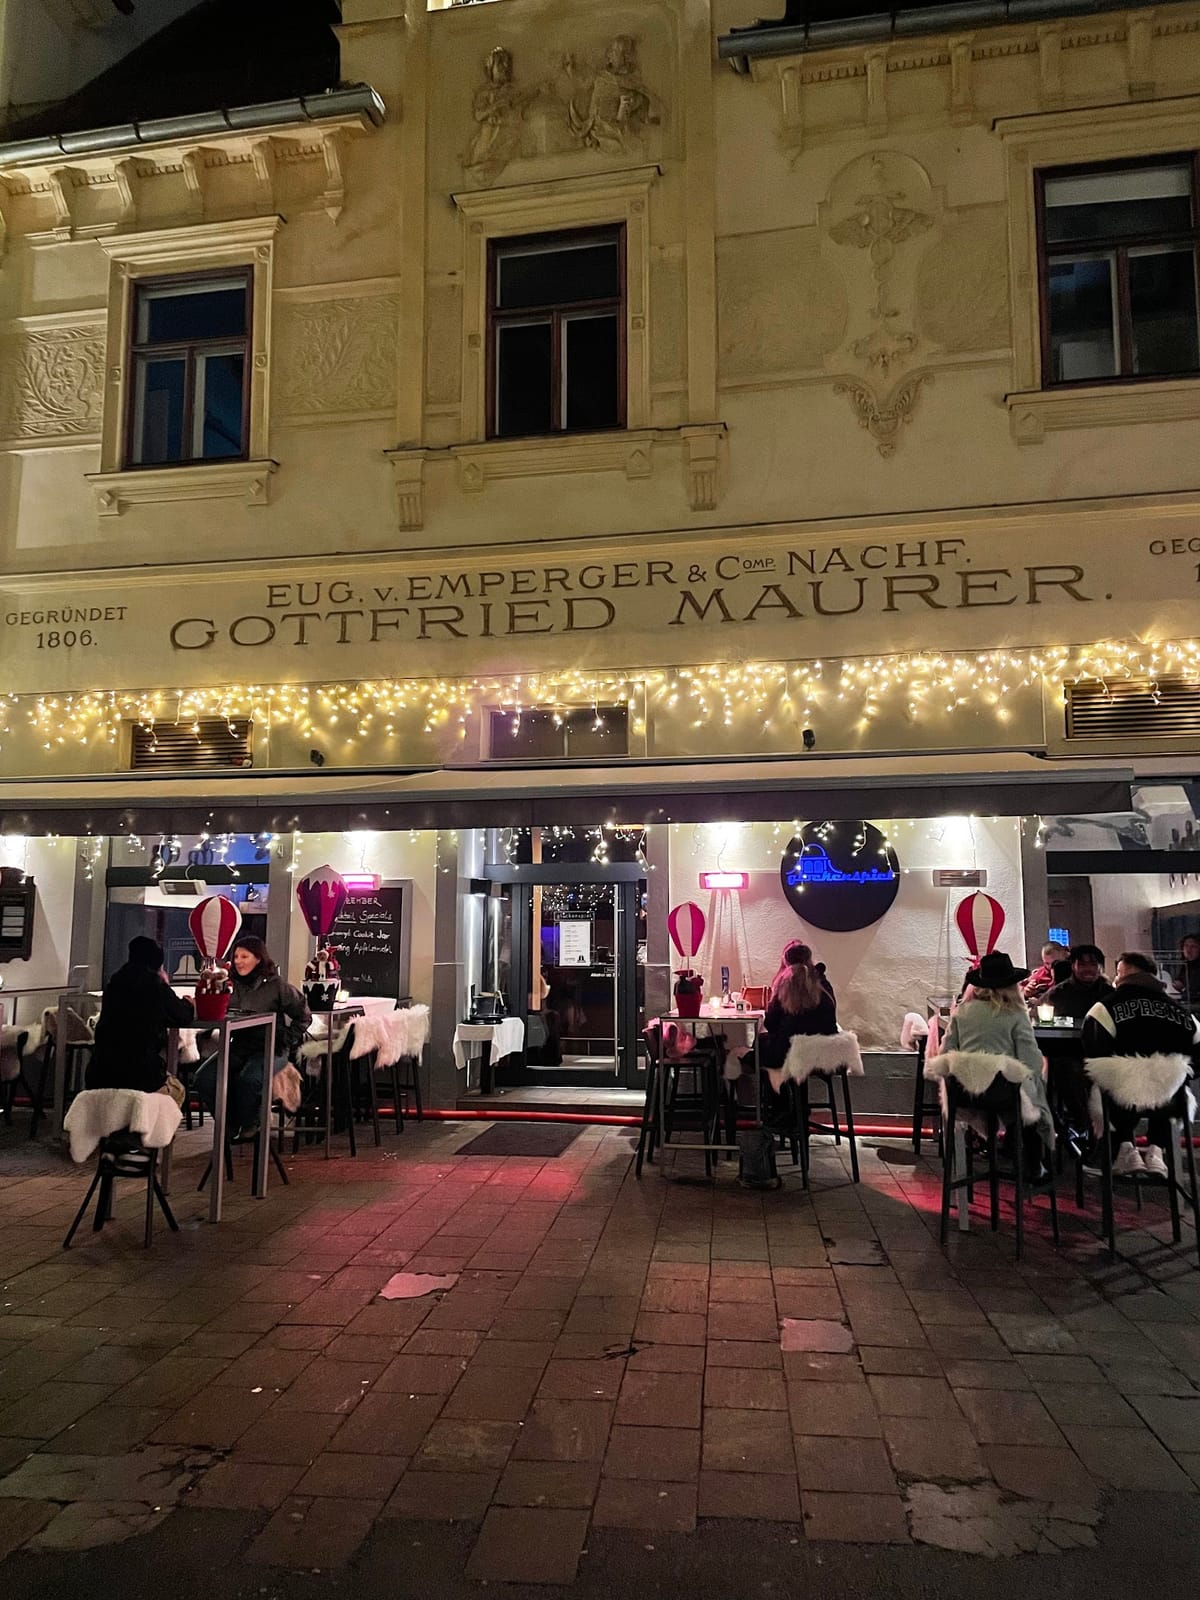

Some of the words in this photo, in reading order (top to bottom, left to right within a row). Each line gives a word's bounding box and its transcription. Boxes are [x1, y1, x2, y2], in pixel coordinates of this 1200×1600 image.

[266, 581, 363, 608] EUG.
[406, 560, 678, 600] EMPERGER
[688, 564, 707, 583] &
[787, 538, 972, 576] NACHF.
[5, 606, 128, 626] GEGRÜNDET
[170, 596, 616, 651] GOTTFRIED
[668, 564, 1114, 625] MAURER.
[36, 629, 98, 649] 1806.
